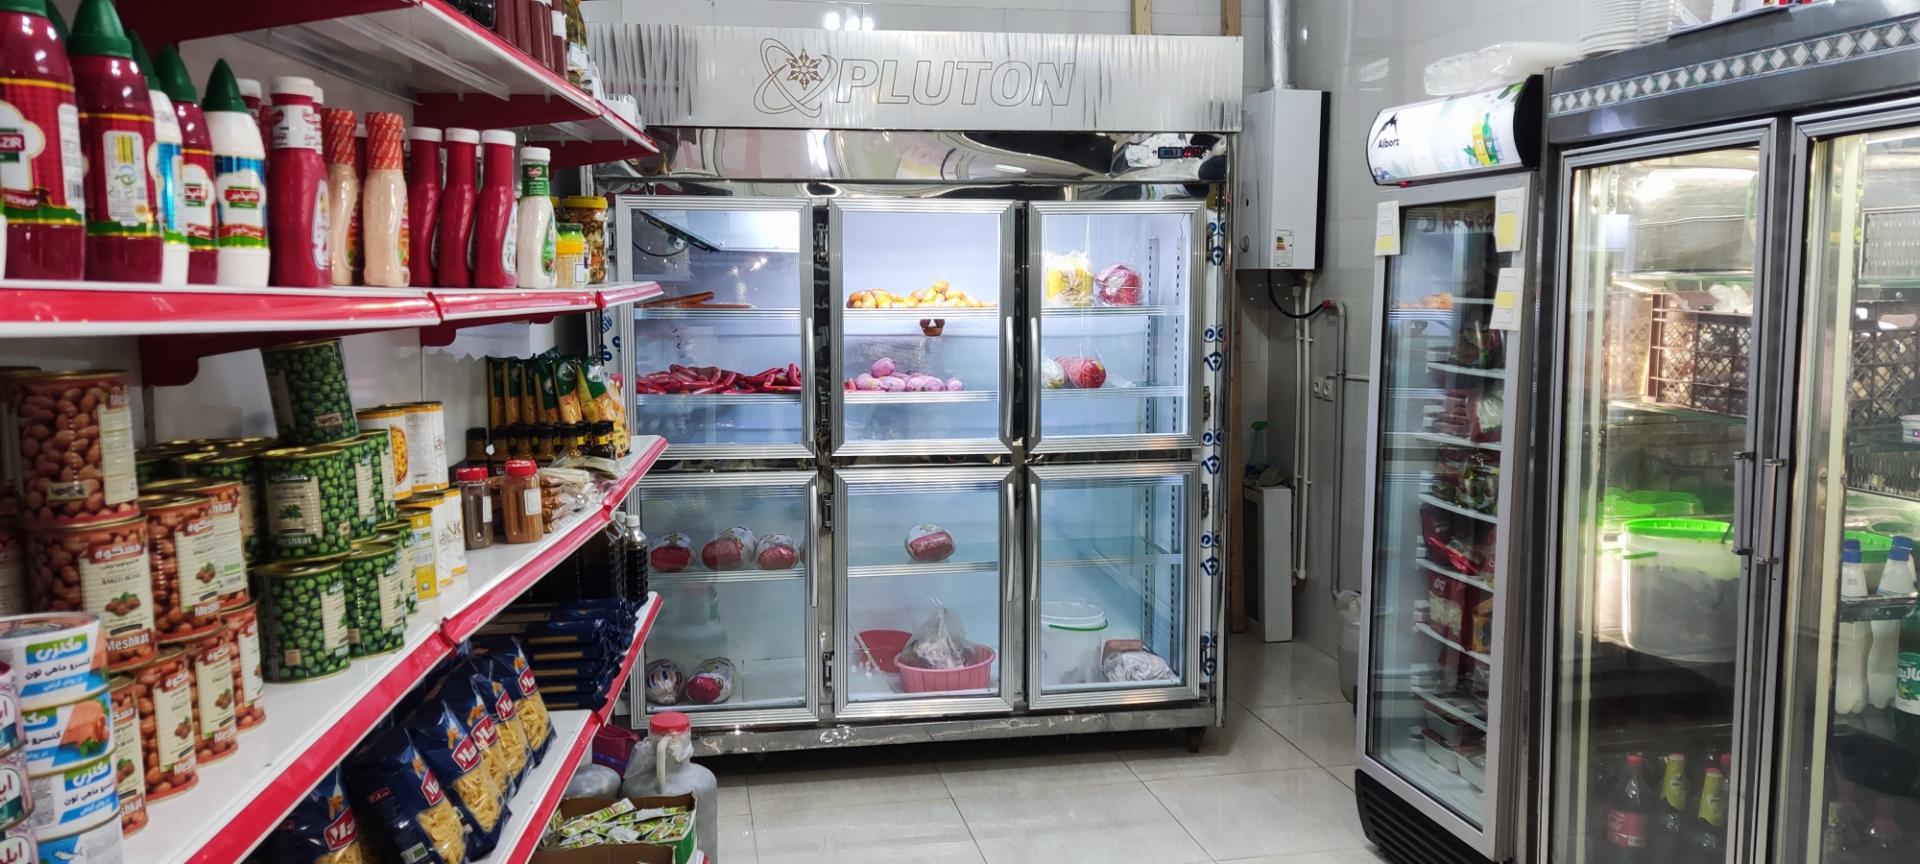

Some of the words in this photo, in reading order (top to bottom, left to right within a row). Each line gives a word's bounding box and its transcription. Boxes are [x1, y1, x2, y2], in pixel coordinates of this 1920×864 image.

[835, 58, 1076, 107] PLUTON
[0, 135, 24, 149] ZIR
[1377, 137, 1400, 150] Alborz
[105, 632, 150, 652] Meshkat
